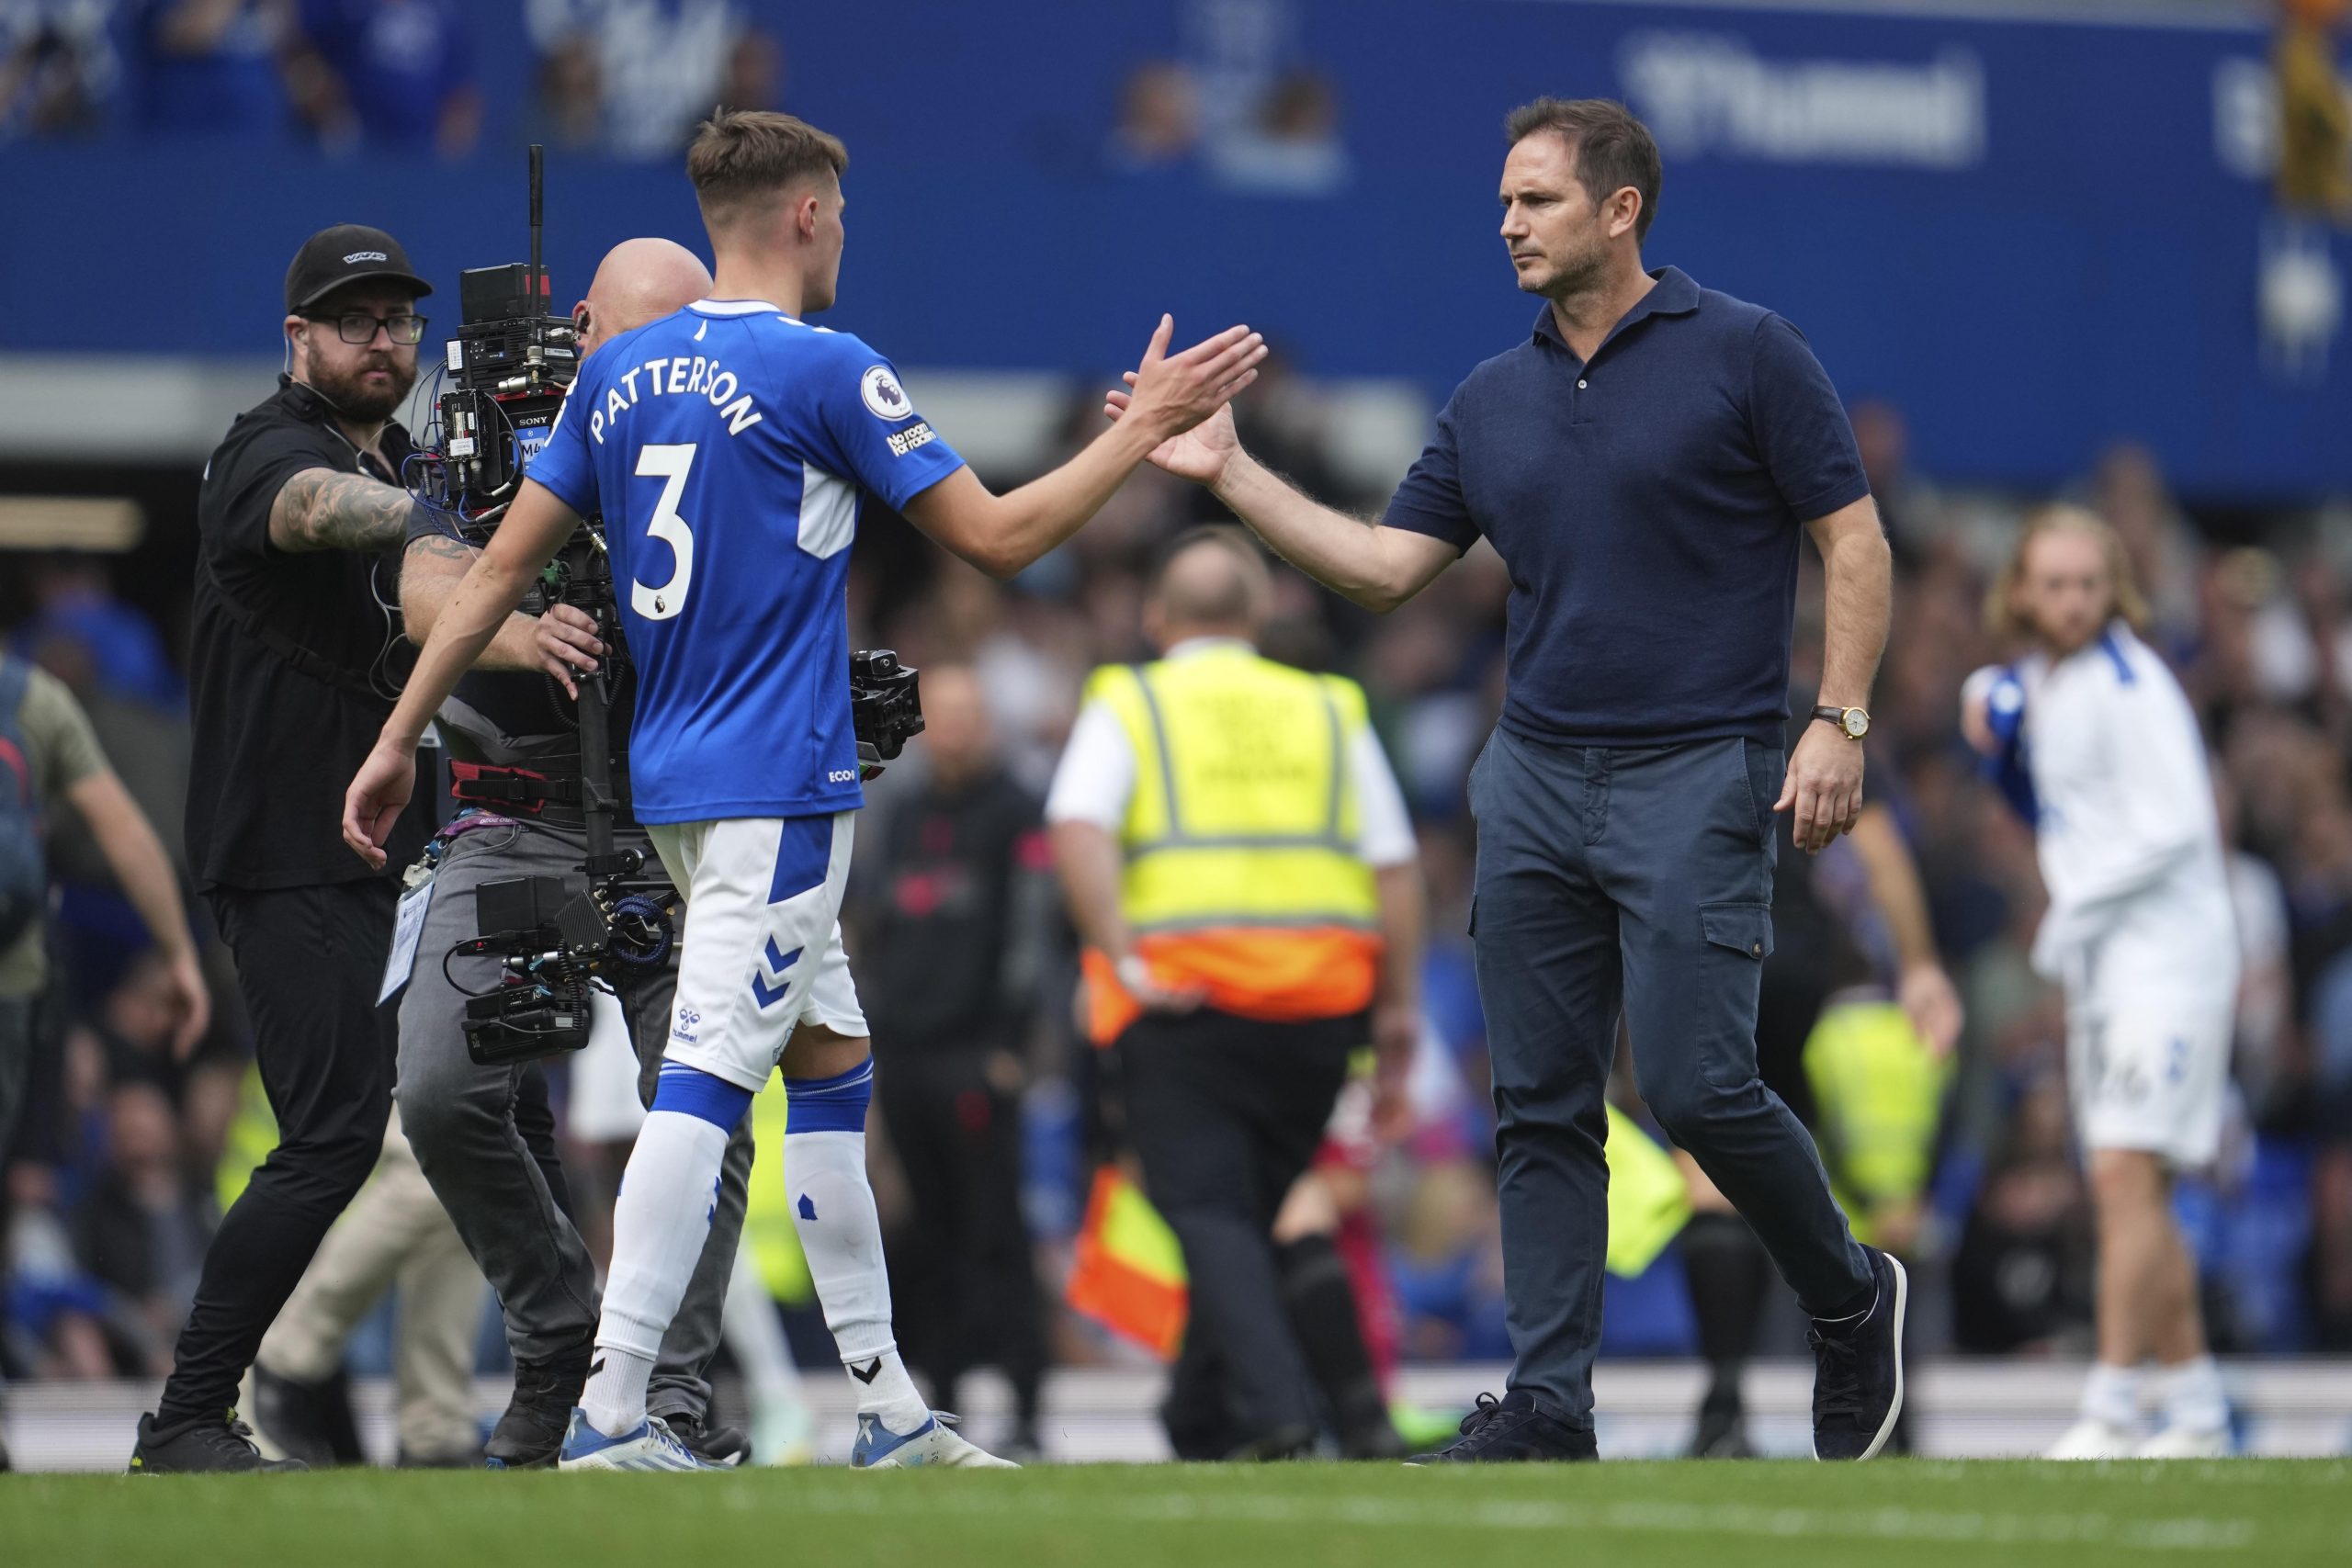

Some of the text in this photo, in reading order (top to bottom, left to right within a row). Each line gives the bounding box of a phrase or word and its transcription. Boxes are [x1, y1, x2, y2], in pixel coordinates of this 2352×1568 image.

[519, 416, 548, 426] SONY
[591, 355, 763, 446] PATTERSON
[887, 423, 929, 446] No room
[631, 443, 697, 620] 3
